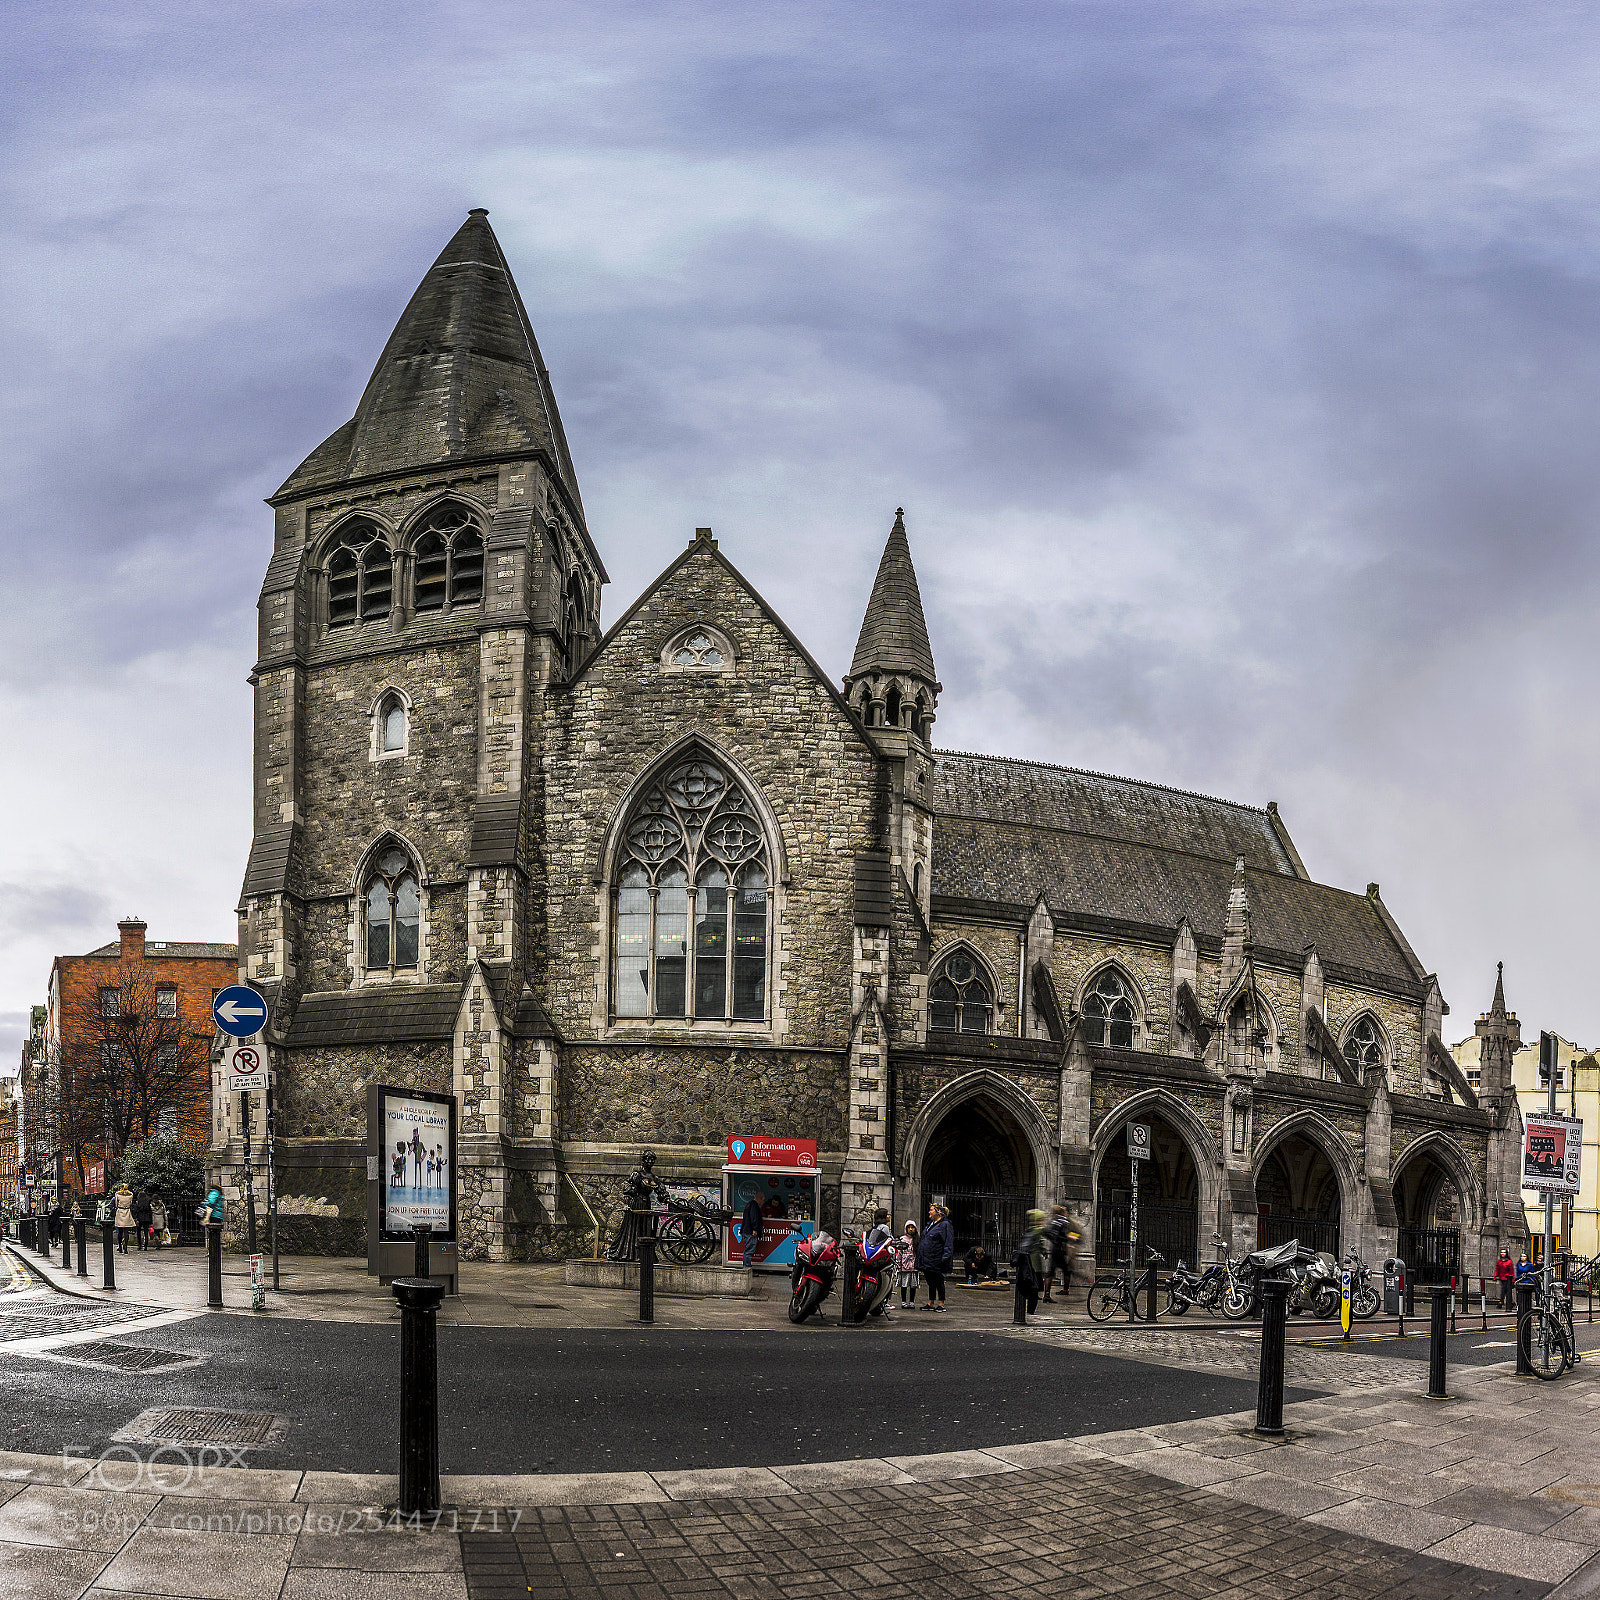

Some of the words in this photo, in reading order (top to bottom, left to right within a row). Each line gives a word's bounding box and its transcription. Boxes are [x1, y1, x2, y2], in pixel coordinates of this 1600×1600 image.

[388, 1112, 404, 1120] YOUR
[405, 1114, 424, 1122] LOCAL
[426, 1116, 447, 1125] LIBRARY
[751, 1141, 796, 1151] Information
[751, 1149, 771, 1158] Point
